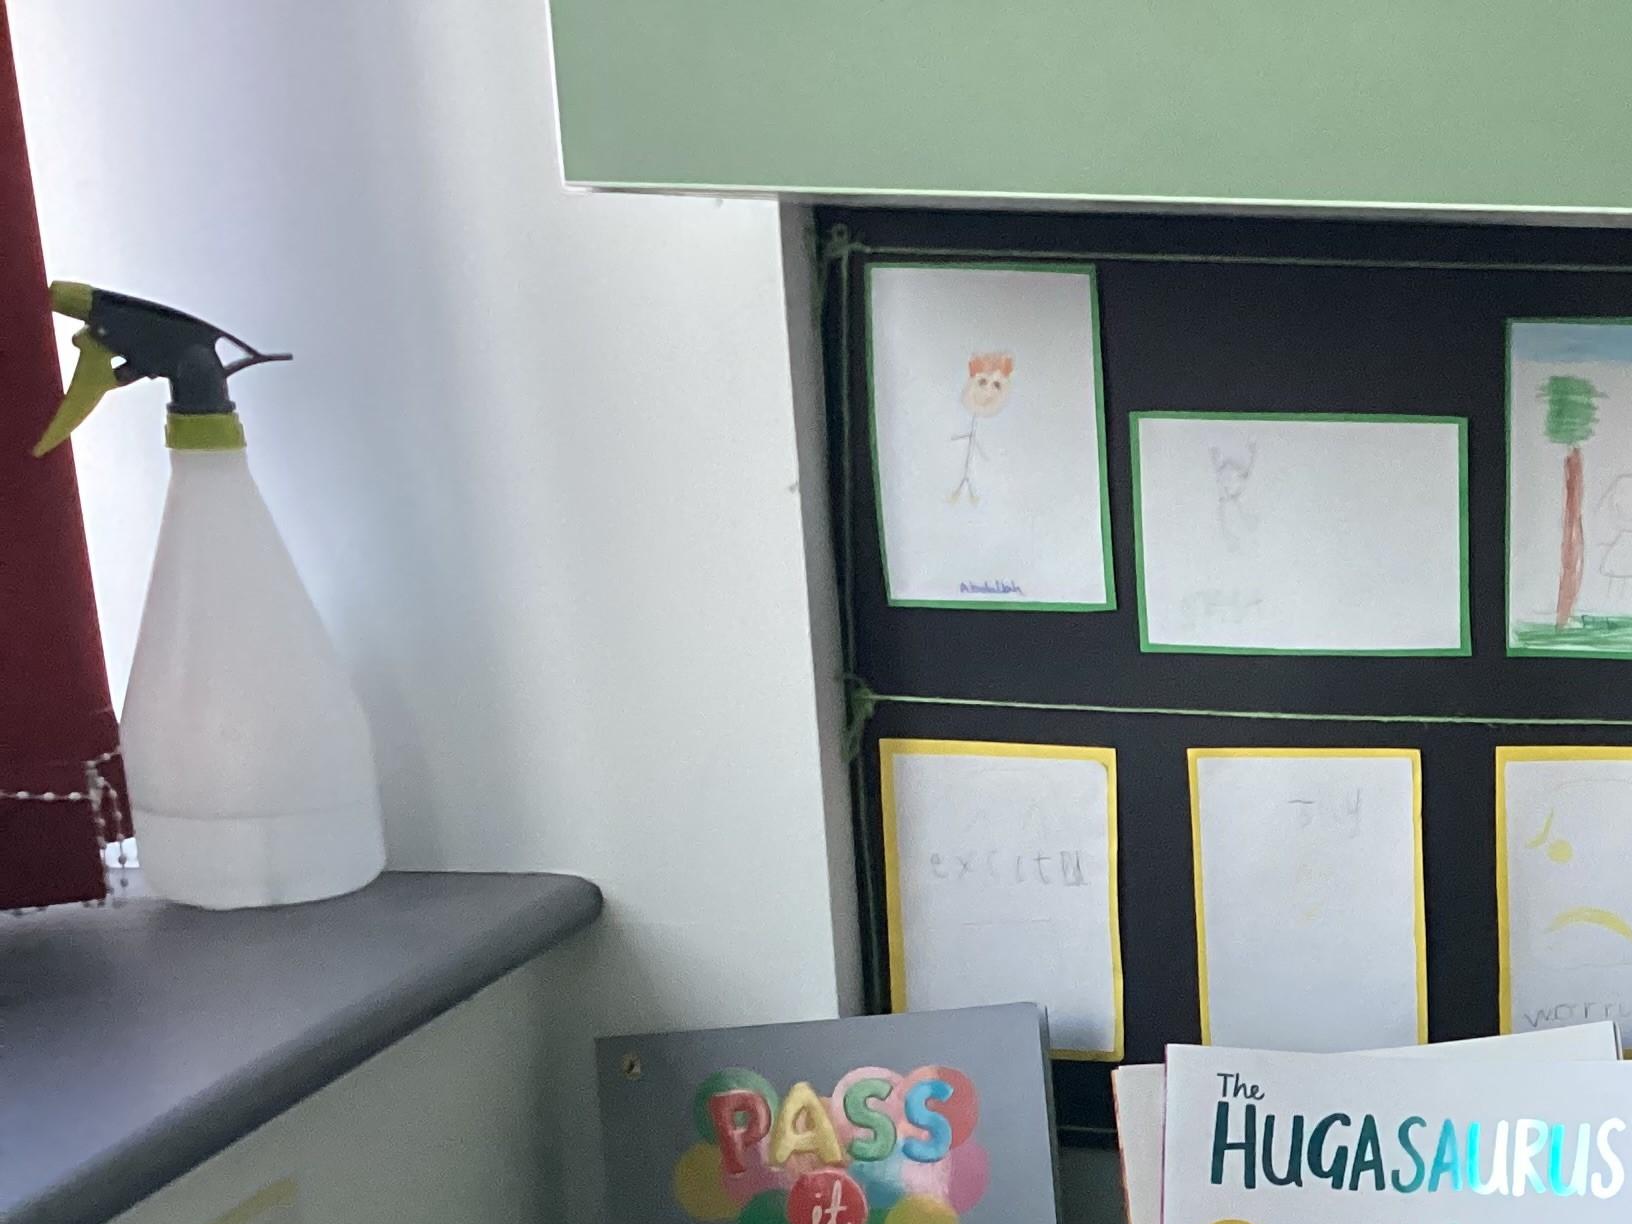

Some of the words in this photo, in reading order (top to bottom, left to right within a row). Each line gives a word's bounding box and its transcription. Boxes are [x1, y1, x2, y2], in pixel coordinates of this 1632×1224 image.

[707, 1079, 954, 1174] PASS
[1216, 1072, 1265, 1100] The
[1210, 1101, 1627, 1199] HUGASAURUS
